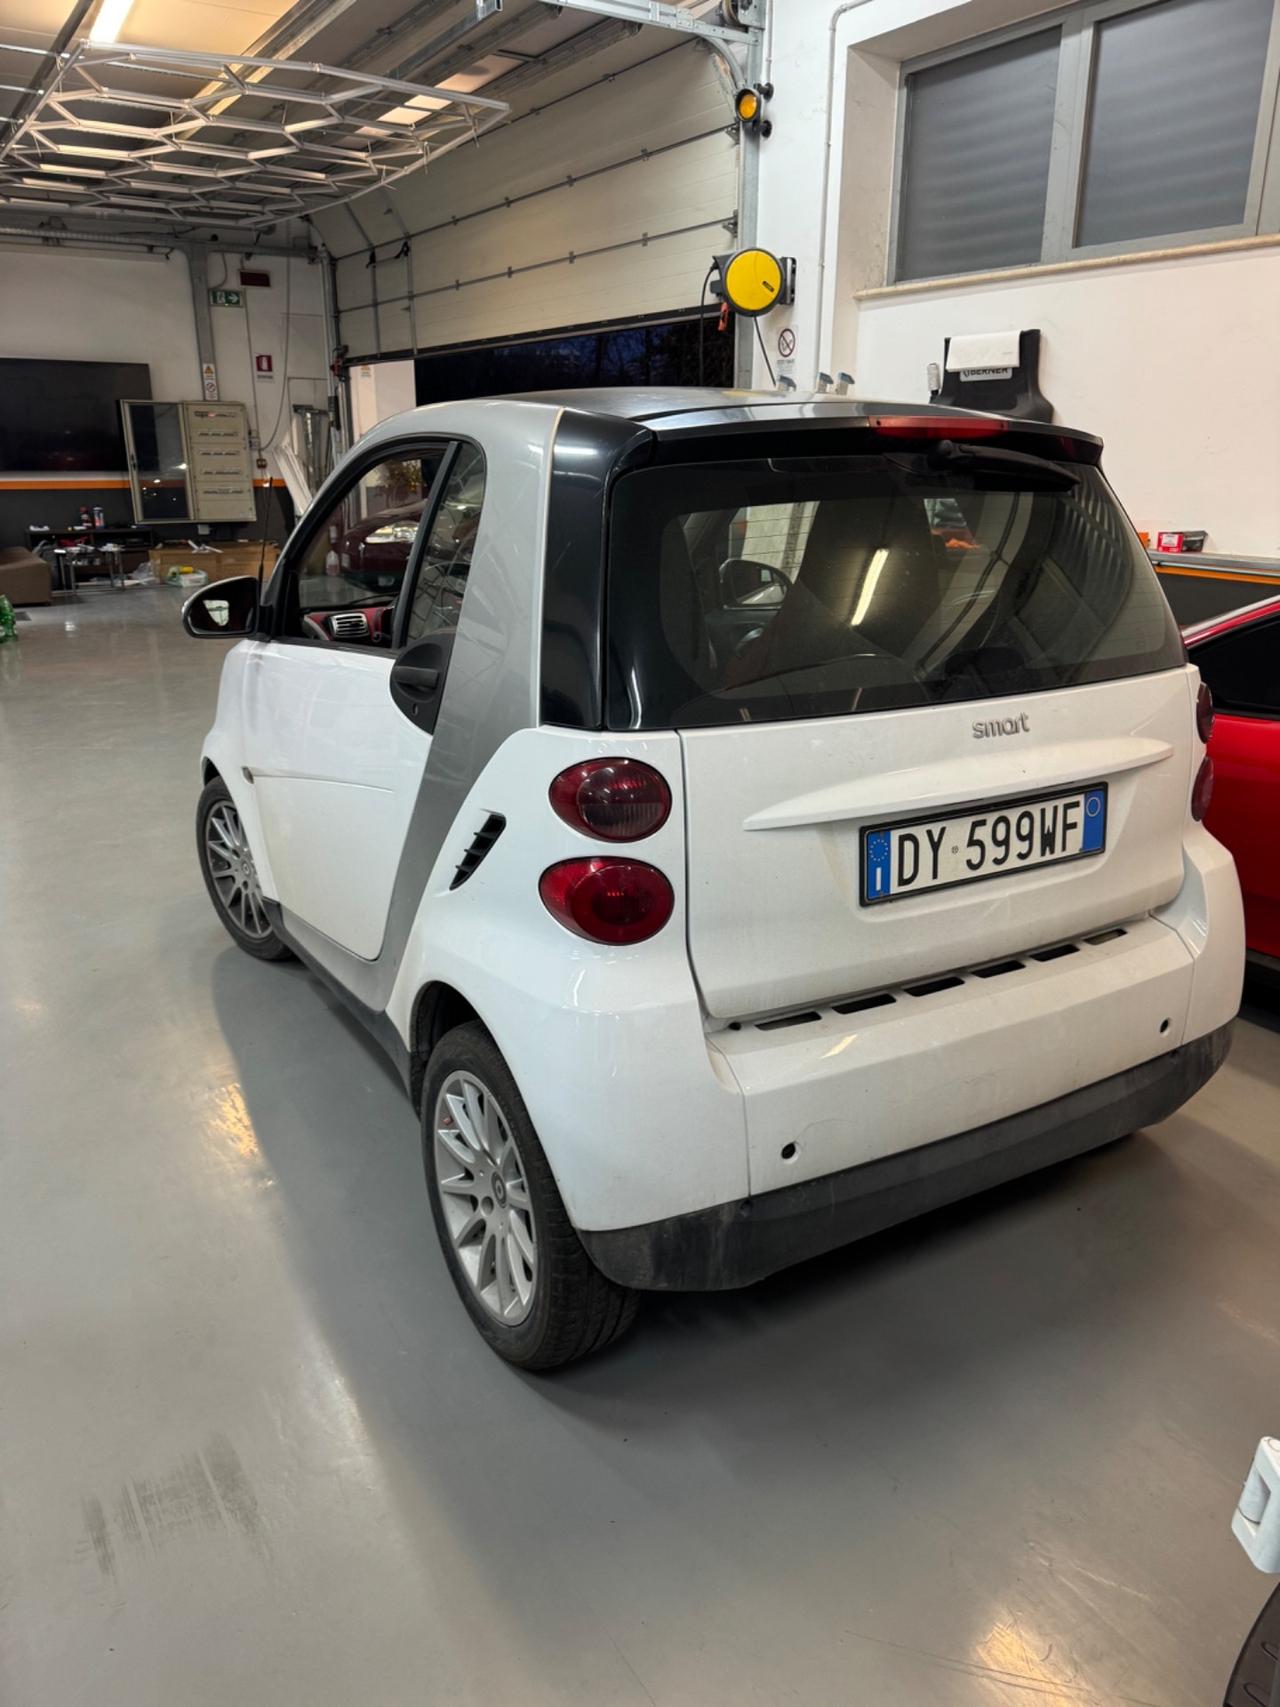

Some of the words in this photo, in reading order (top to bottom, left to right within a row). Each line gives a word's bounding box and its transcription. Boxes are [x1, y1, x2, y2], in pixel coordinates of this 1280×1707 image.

[972, 712, 1030, 739] smart
[898, 826, 946, 887] DY
[966, 801, 1081, 871] 599WF
